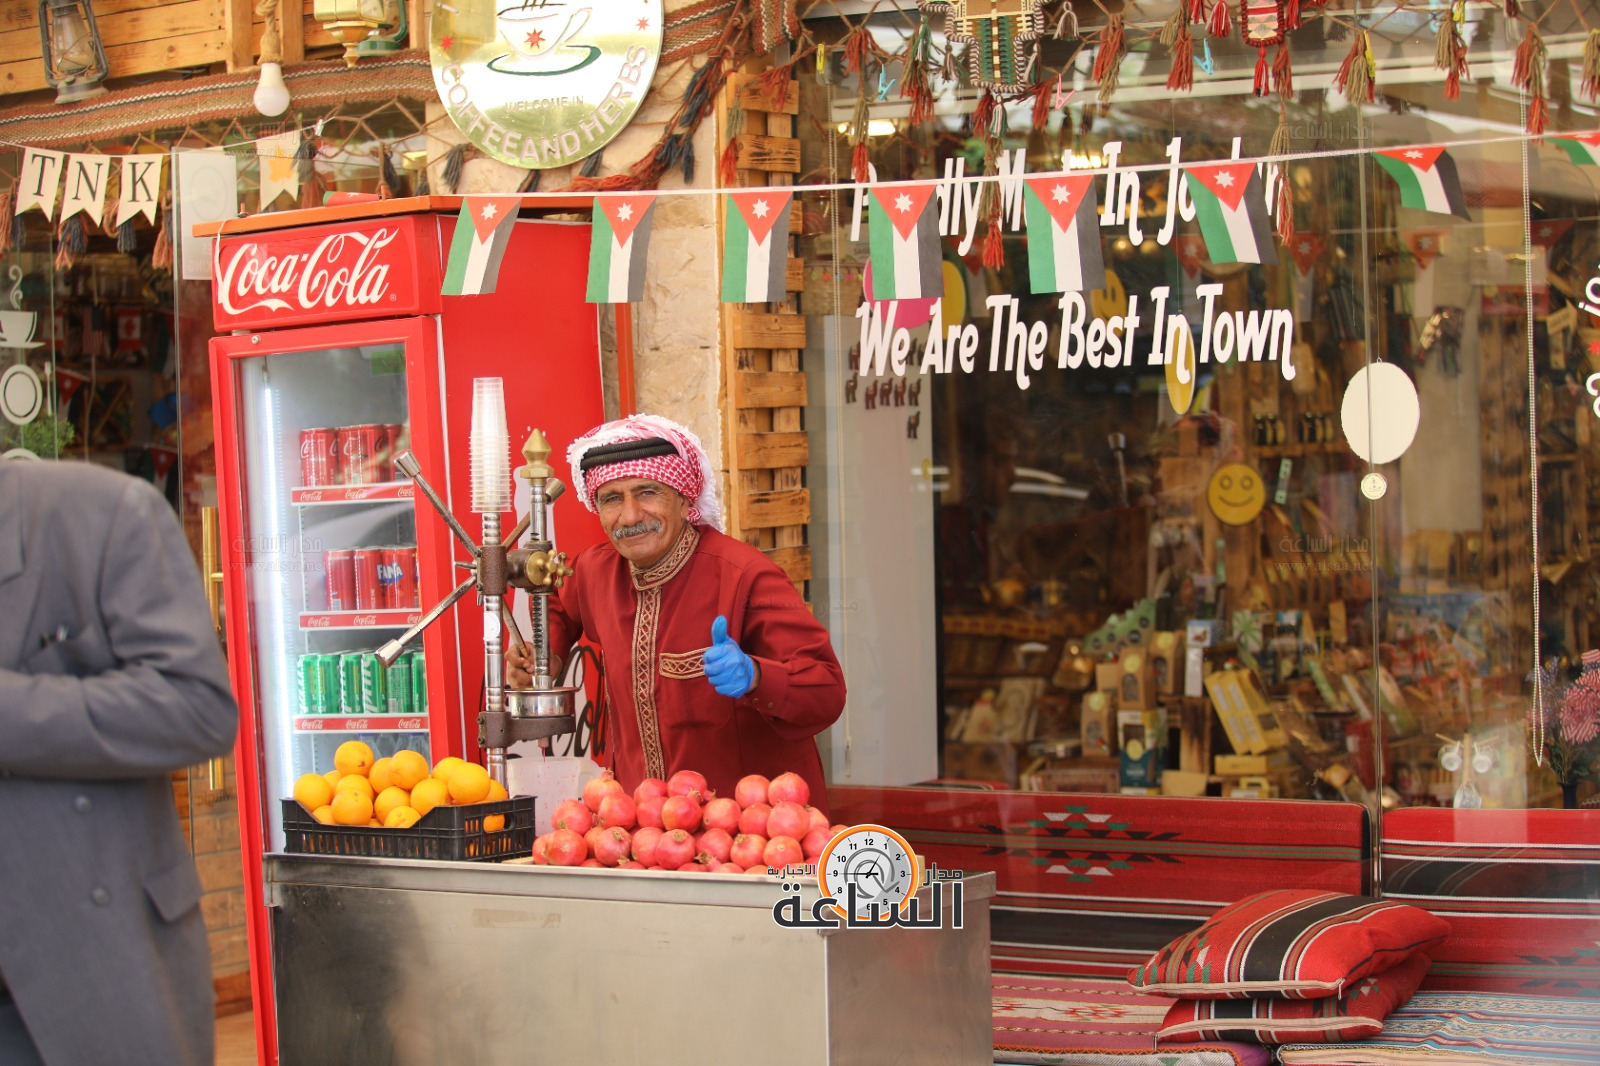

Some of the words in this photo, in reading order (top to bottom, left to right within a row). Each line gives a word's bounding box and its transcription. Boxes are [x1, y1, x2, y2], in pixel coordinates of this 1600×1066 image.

[505, 96, 570, 112] WELCOME
[572, 95, 584, 107] IN
[579, 44, 650, 142] HERBS
[1100, 141, 1143, 246] In
[222, 227, 400, 315] Coca-Cola
[855, 300, 911, 377] We
[920, 297, 979, 375] Are
[985, 294, 1048, 390] The
[1057, 290, 1140, 369] Best
[1148, 286, 1191, 384] In
[1195, 283, 1296, 381] Town
